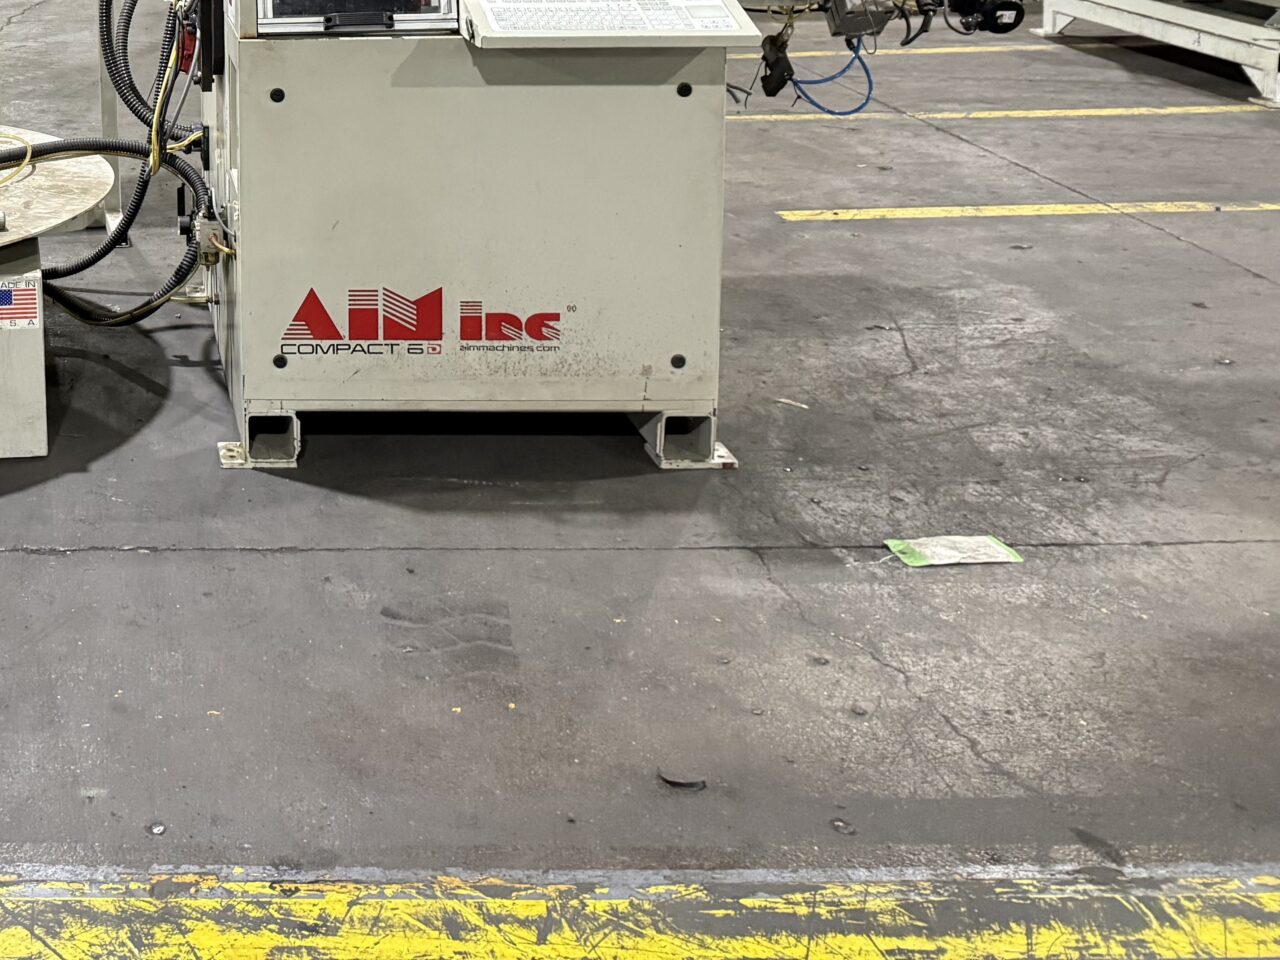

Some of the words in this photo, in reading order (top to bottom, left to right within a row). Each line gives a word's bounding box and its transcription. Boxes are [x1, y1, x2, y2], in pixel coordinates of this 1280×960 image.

[281, 287, 443, 341] AIM
[460, 300, 560, 341] inc
[281, 343, 400, 355] COMPACT
[460, 343, 560, 352] aimmachines.com
